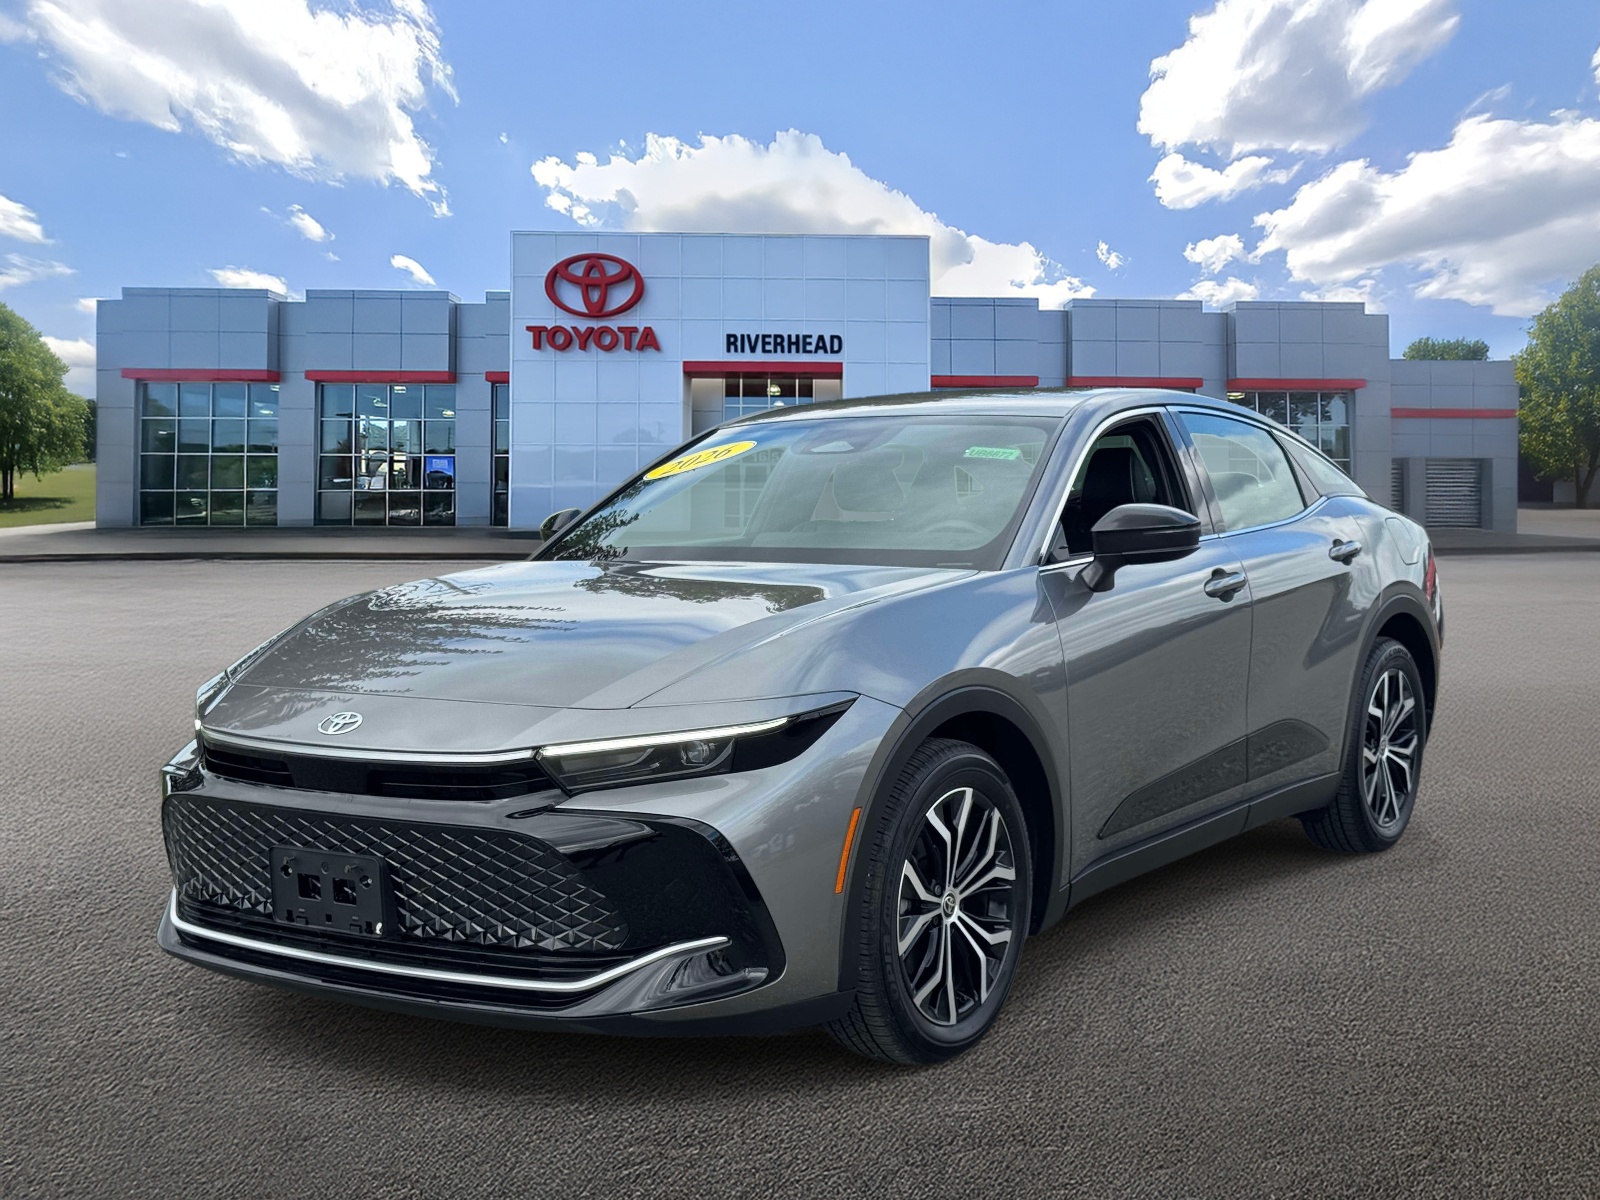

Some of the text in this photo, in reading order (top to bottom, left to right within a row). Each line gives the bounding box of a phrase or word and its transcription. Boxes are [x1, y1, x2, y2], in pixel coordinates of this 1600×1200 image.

[526, 326, 661, 352] TOYOTA
[726, 334, 843, 354] RIVERHEAD
[658, 444, 738, 476] 2026
